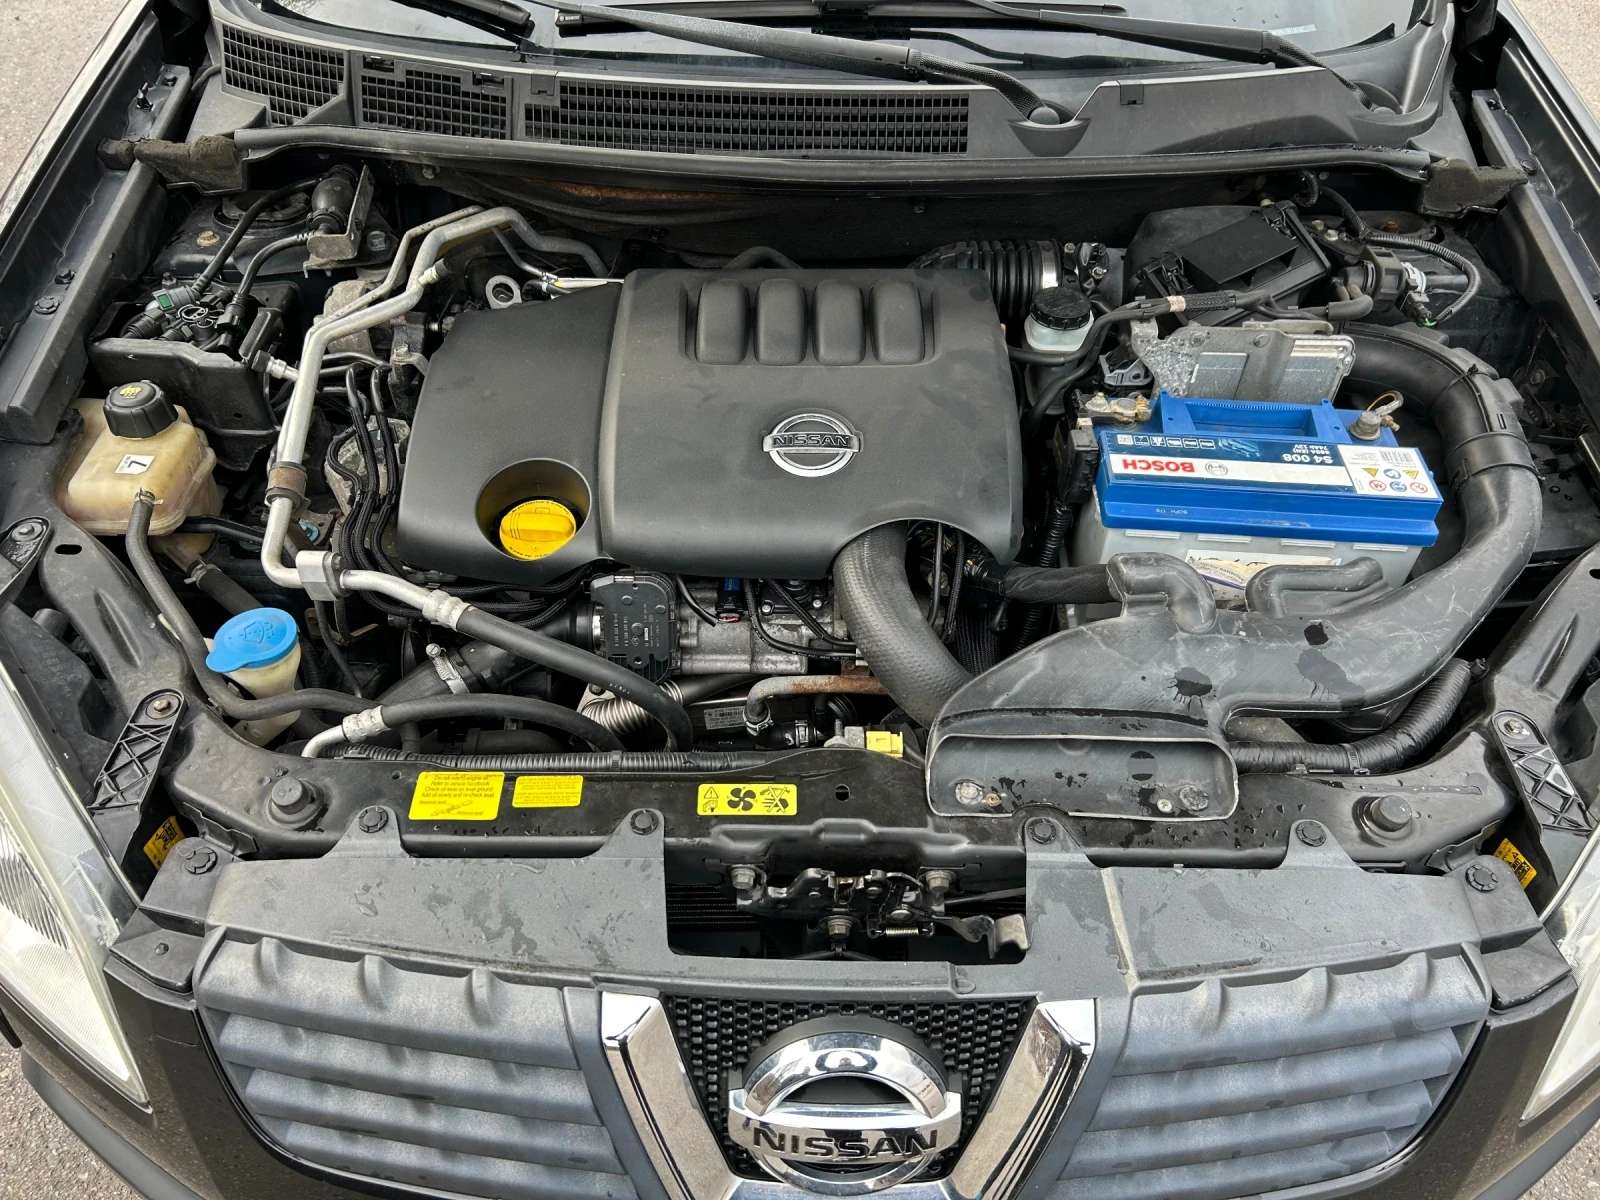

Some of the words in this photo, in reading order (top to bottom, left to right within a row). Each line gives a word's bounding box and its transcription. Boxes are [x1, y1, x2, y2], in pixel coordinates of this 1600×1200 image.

[773, 434, 850, 446] NISSAN
[1282, 454, 1310, 462] 008
[1313, 455, 1333, 464] S4
[1122, 459, 1195, 473] BOSCH
[752, 1128, 938, 1159] NISSAN
